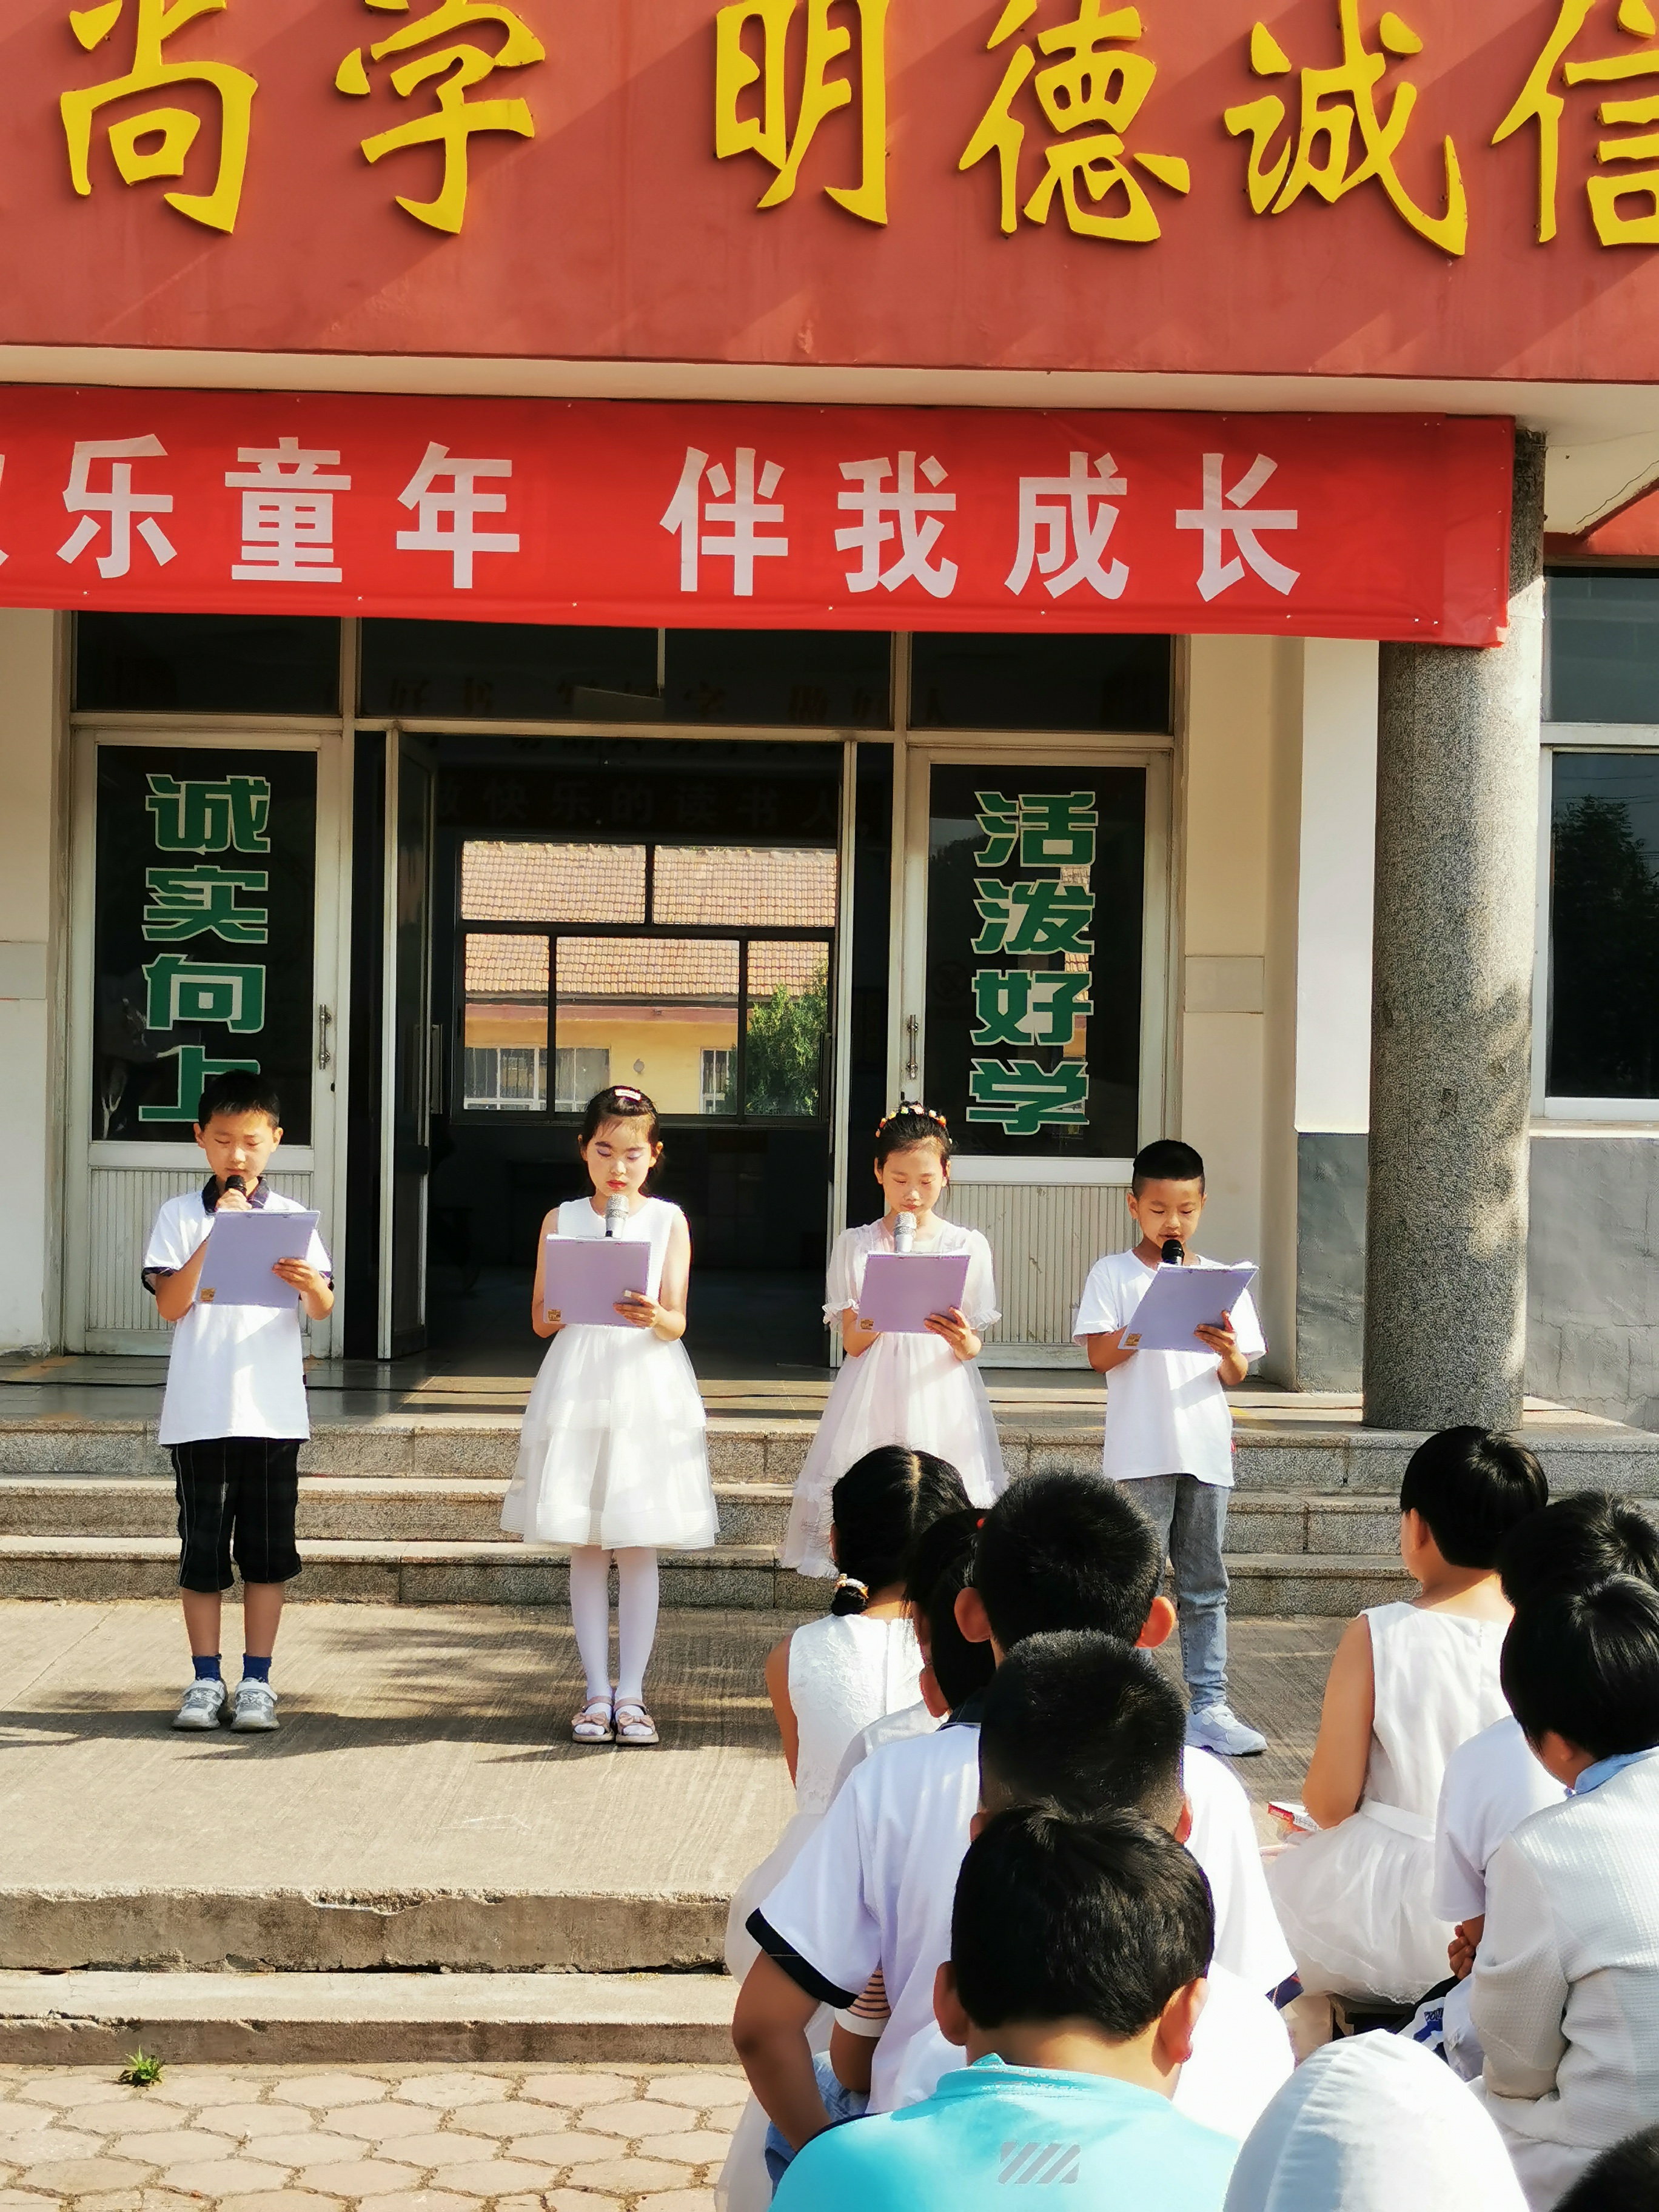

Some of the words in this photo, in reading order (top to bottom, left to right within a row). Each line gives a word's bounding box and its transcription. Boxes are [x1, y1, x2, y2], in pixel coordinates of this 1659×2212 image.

[60, 0, 546, 234] 尚学
[716, 0, 1659, 255] 明德诚信
[0, 434, 520, 589] 乐童年
[659, 446, 1300, 602] 伴我成长
[138, 773, 271, 1122] 诚实向上
[966, 791, 1099, 1136] 活泼好学
